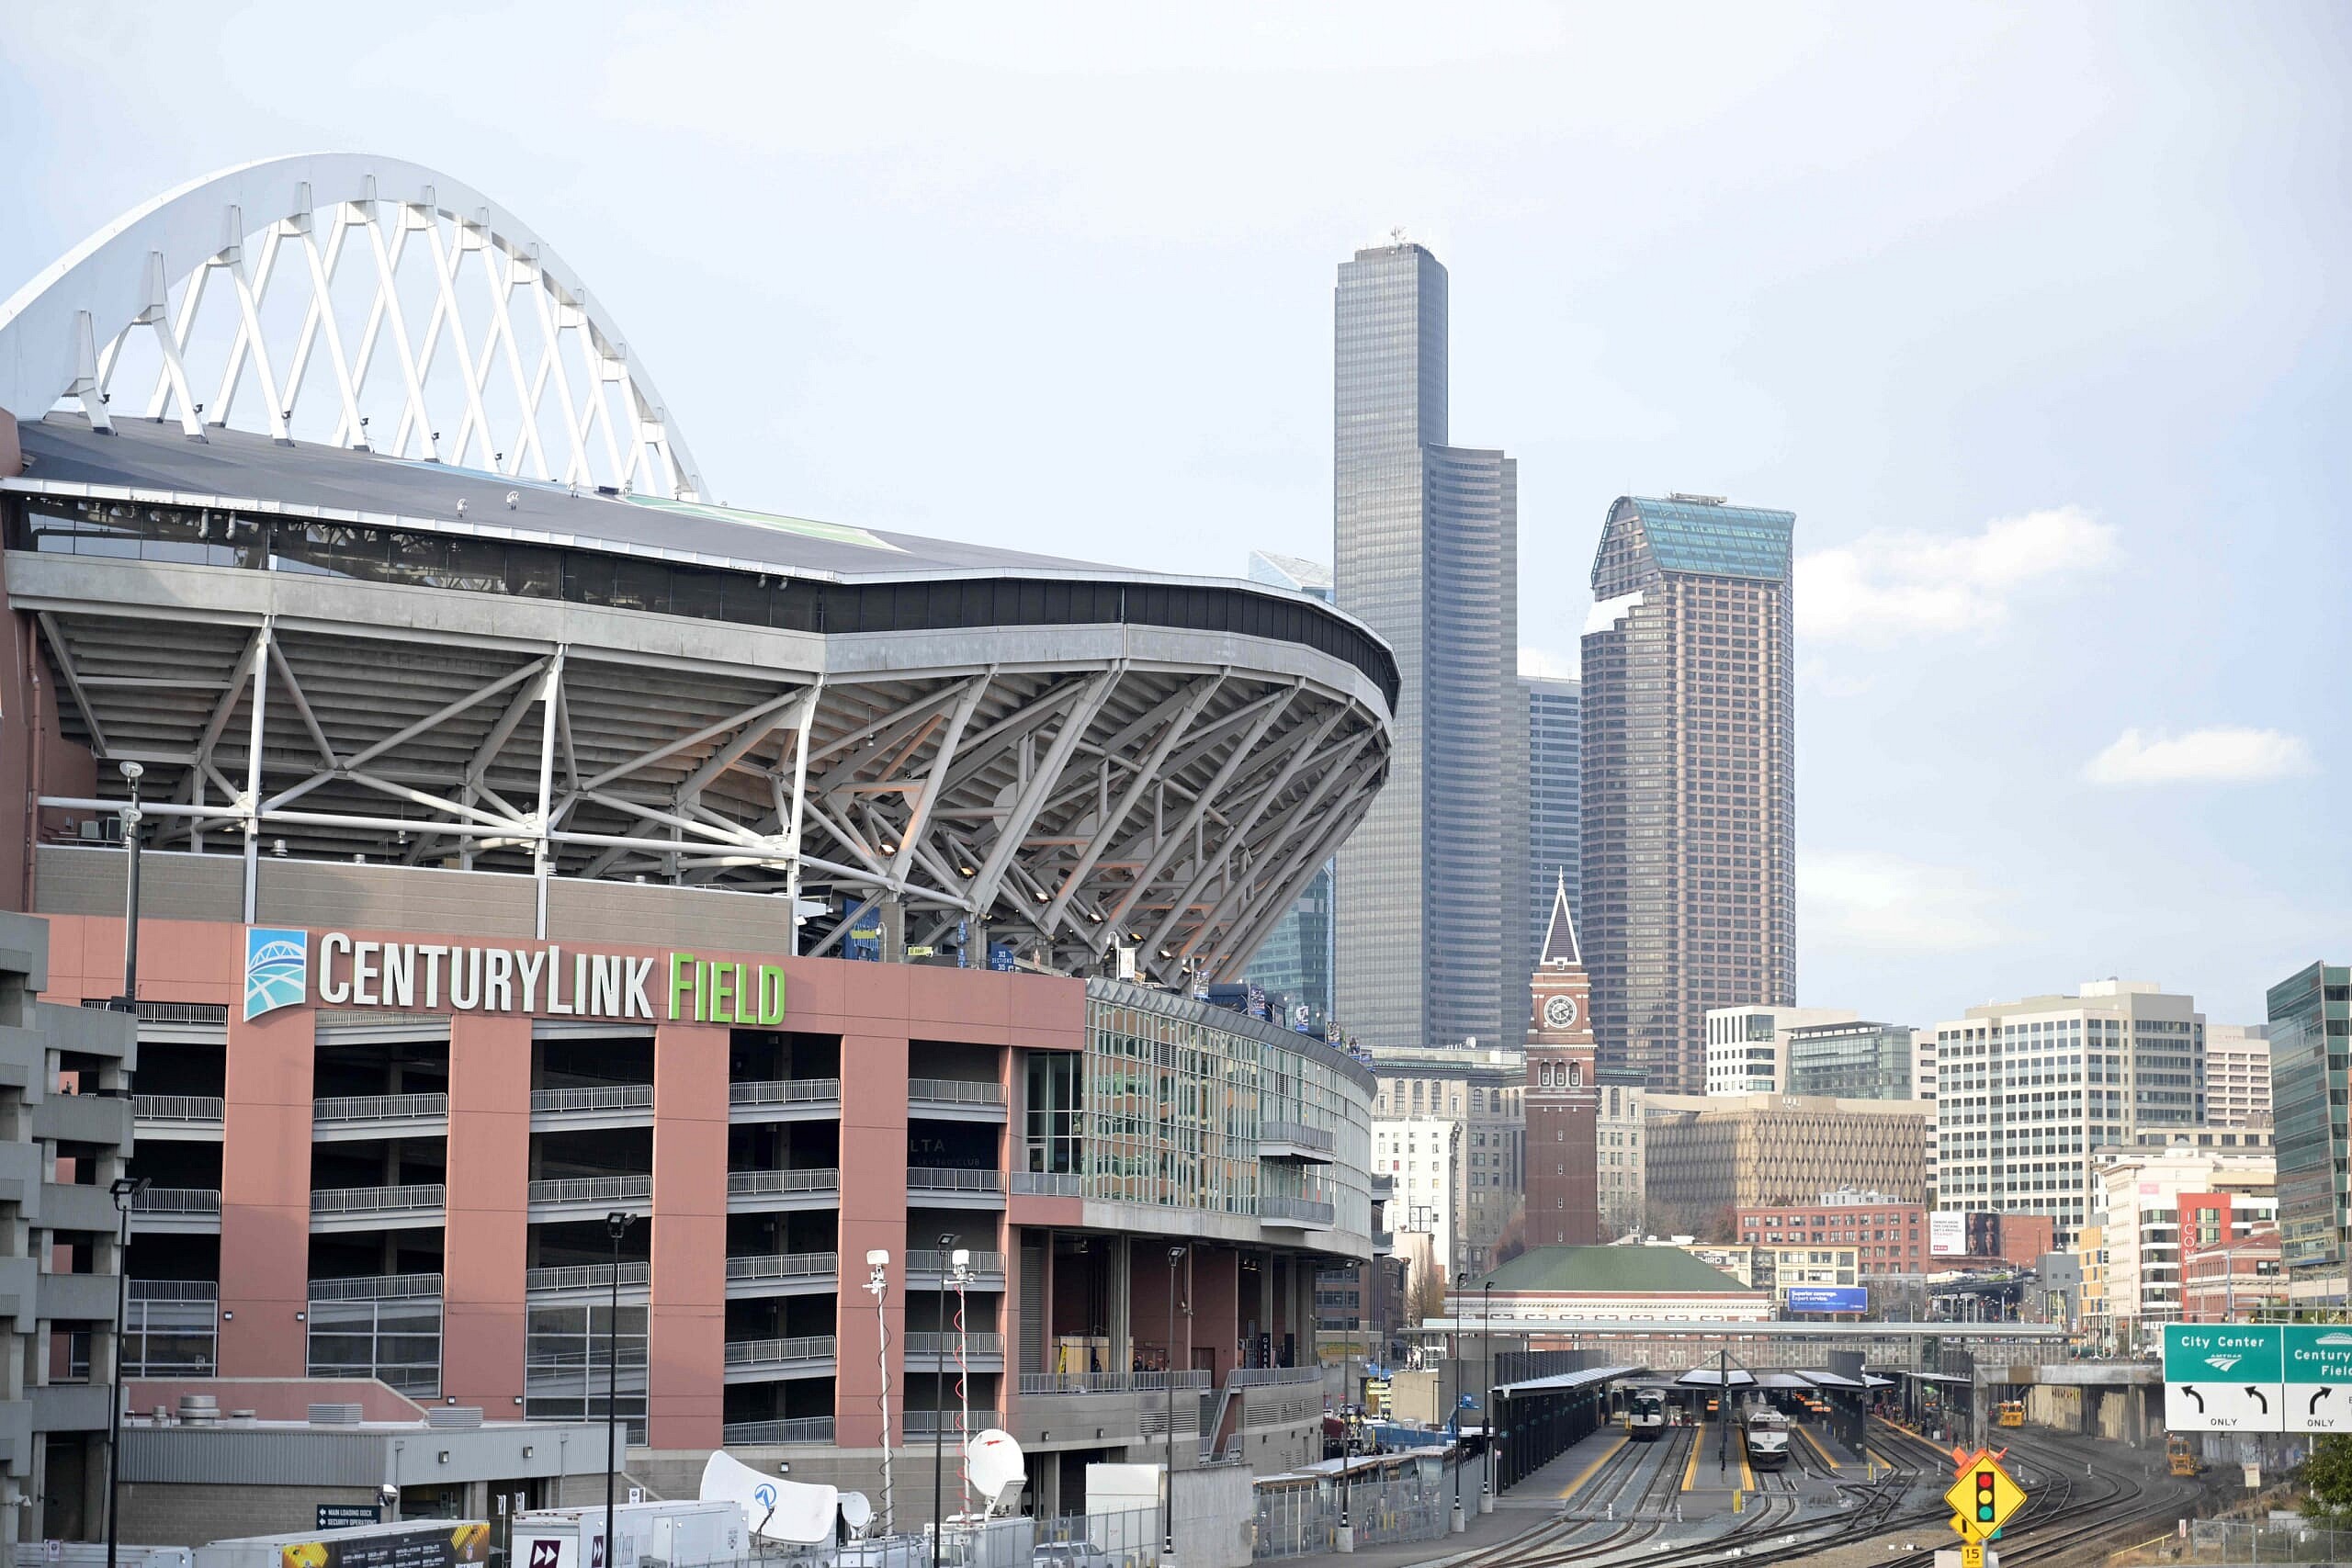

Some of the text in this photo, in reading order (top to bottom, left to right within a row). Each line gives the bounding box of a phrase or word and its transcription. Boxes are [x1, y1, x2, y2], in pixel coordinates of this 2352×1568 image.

[669, 953, 786, 1025] FIELD
[910, 1139, 945, 1153] LTA
[2181, 1337, 2265, 1348] City Center
[2211, 1418, 2237, 1427] ONLY
[2307, 1419, 2335, 1427] ONLY
[1966, 1549, 1979, 1559] 15
